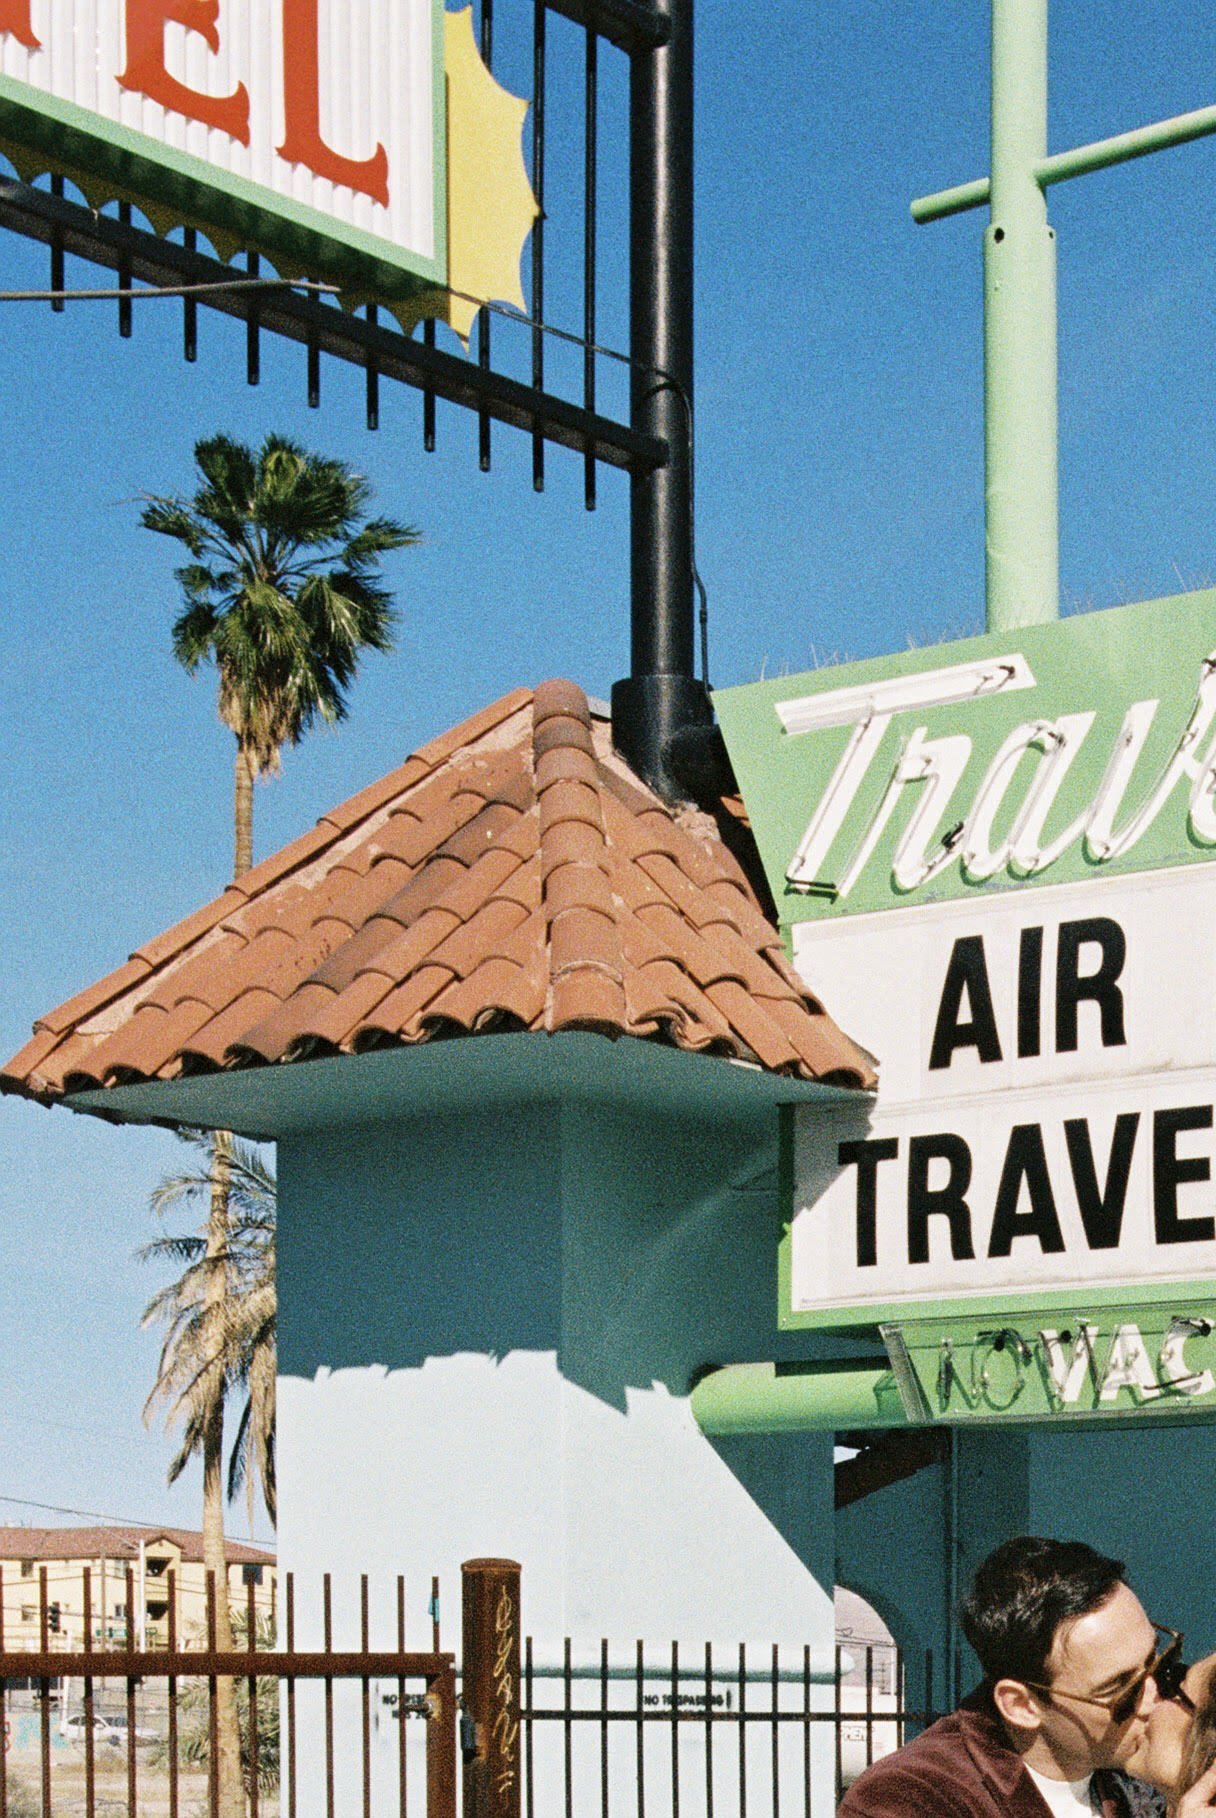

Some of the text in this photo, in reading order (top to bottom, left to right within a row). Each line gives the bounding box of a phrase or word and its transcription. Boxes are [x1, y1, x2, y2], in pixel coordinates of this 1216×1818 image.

[0, 0, 389, 209] EL
[928, 916, 1128, 1071] AIR
[936, 1327, 1034, 1412] NO
